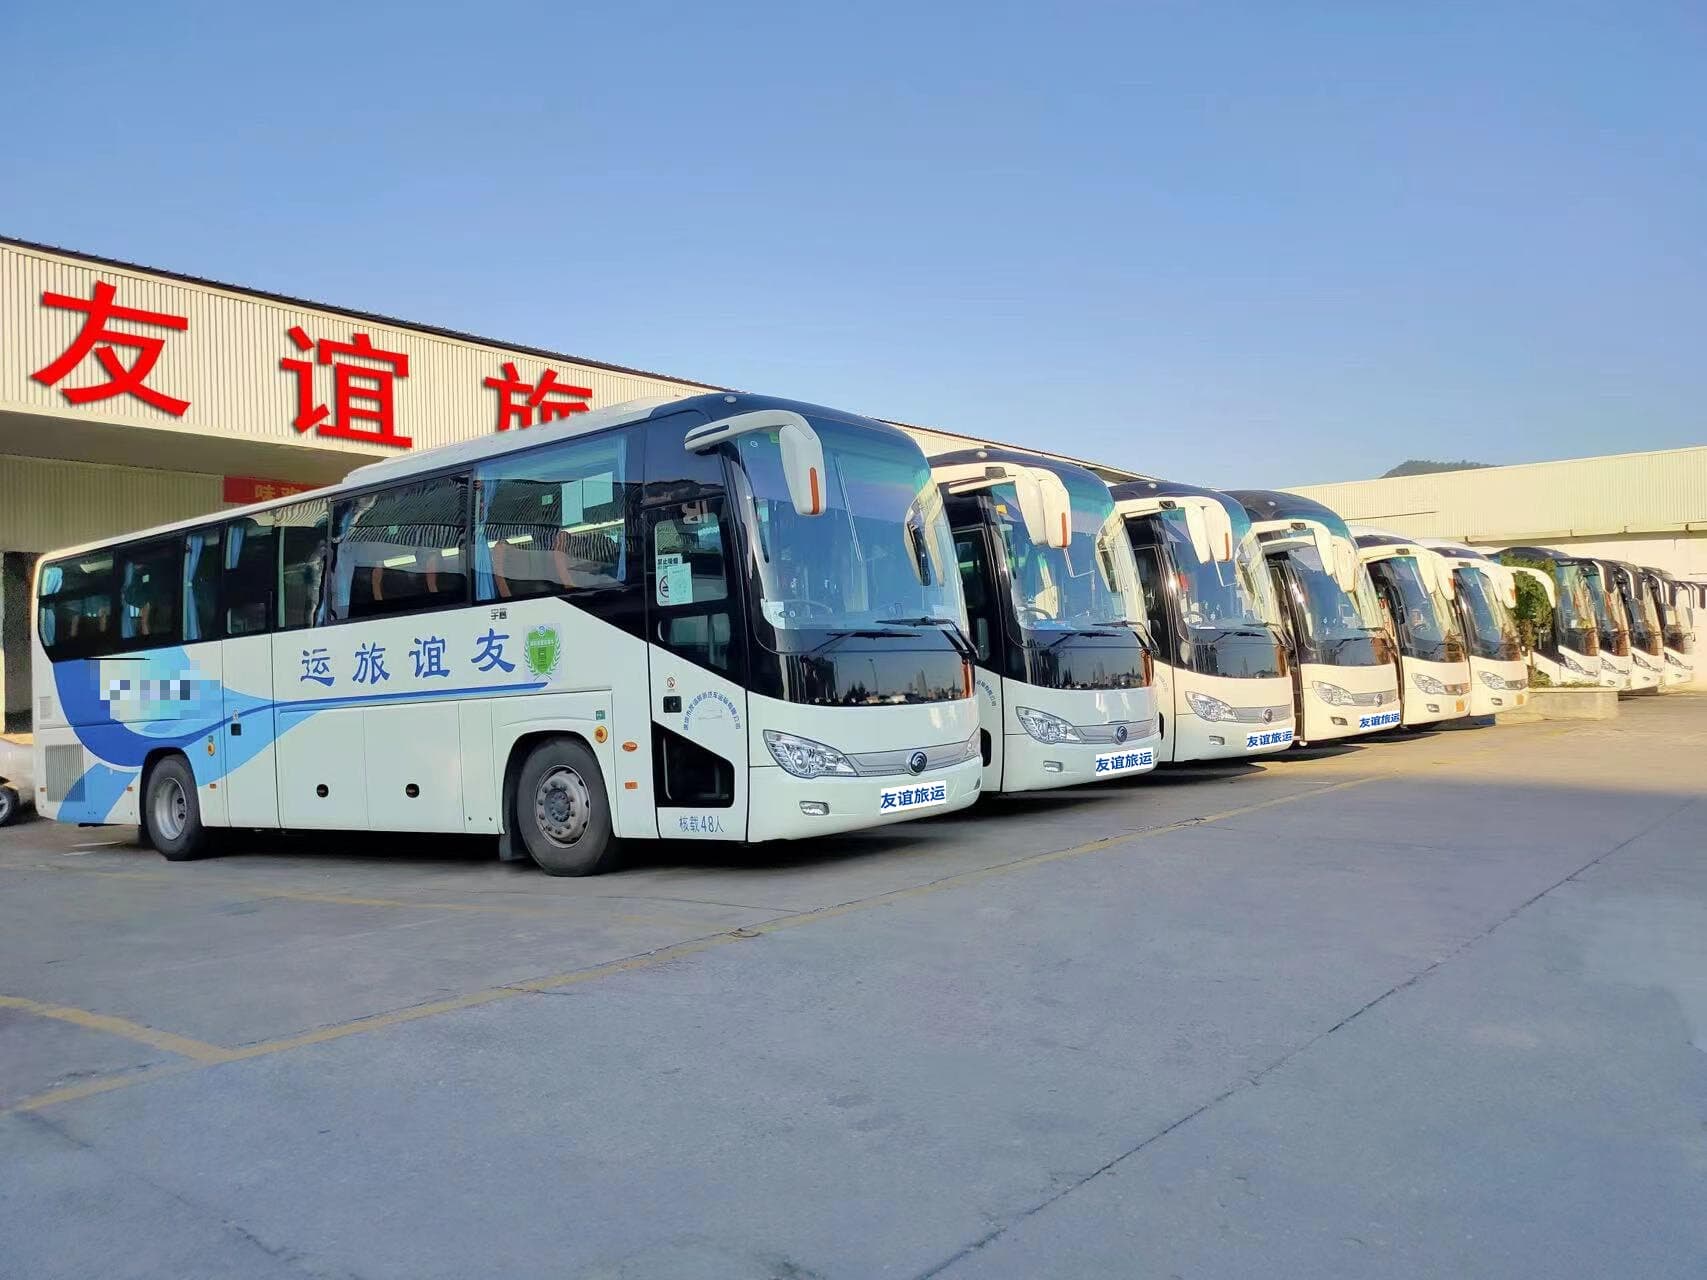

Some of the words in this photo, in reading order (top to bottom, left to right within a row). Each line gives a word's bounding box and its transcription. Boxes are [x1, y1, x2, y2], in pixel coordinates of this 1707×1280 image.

[1360, 713, 1400, 729] 友谊旅运
[1247, 730, 1293, 747] 友谊旅运
[1096, 751, 1152, 773] 友谊旅运
[881, 785, 945, 809] 友谊旅运
[679, 815, 725, 833] 核载48人
